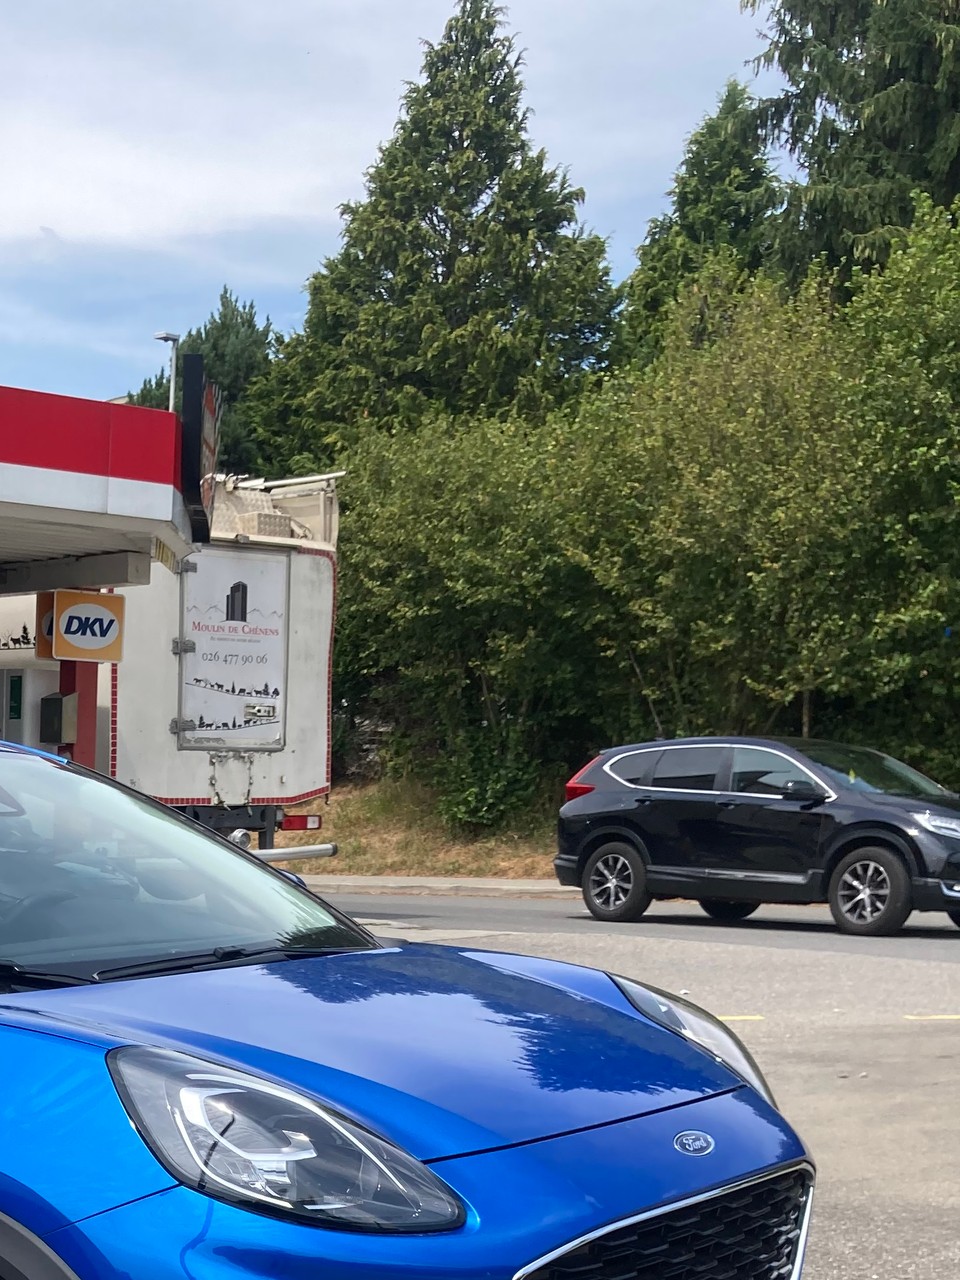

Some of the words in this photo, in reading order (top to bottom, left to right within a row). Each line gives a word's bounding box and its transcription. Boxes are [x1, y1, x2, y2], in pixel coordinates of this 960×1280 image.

[64, 615, 115, 637] DKV
[192, 621, 225, 632] MOULIN
[228, 626, 239, 634] DE
[241, 624, 279, 636] CHÉNENS
[202, 651, 220, 662] 026
[222, 654, 240, 666] 477
[241, 655, 253, 666] 90
[255, 653, 268, 665] 06
[682, 1135, 707, 1151] Ford
